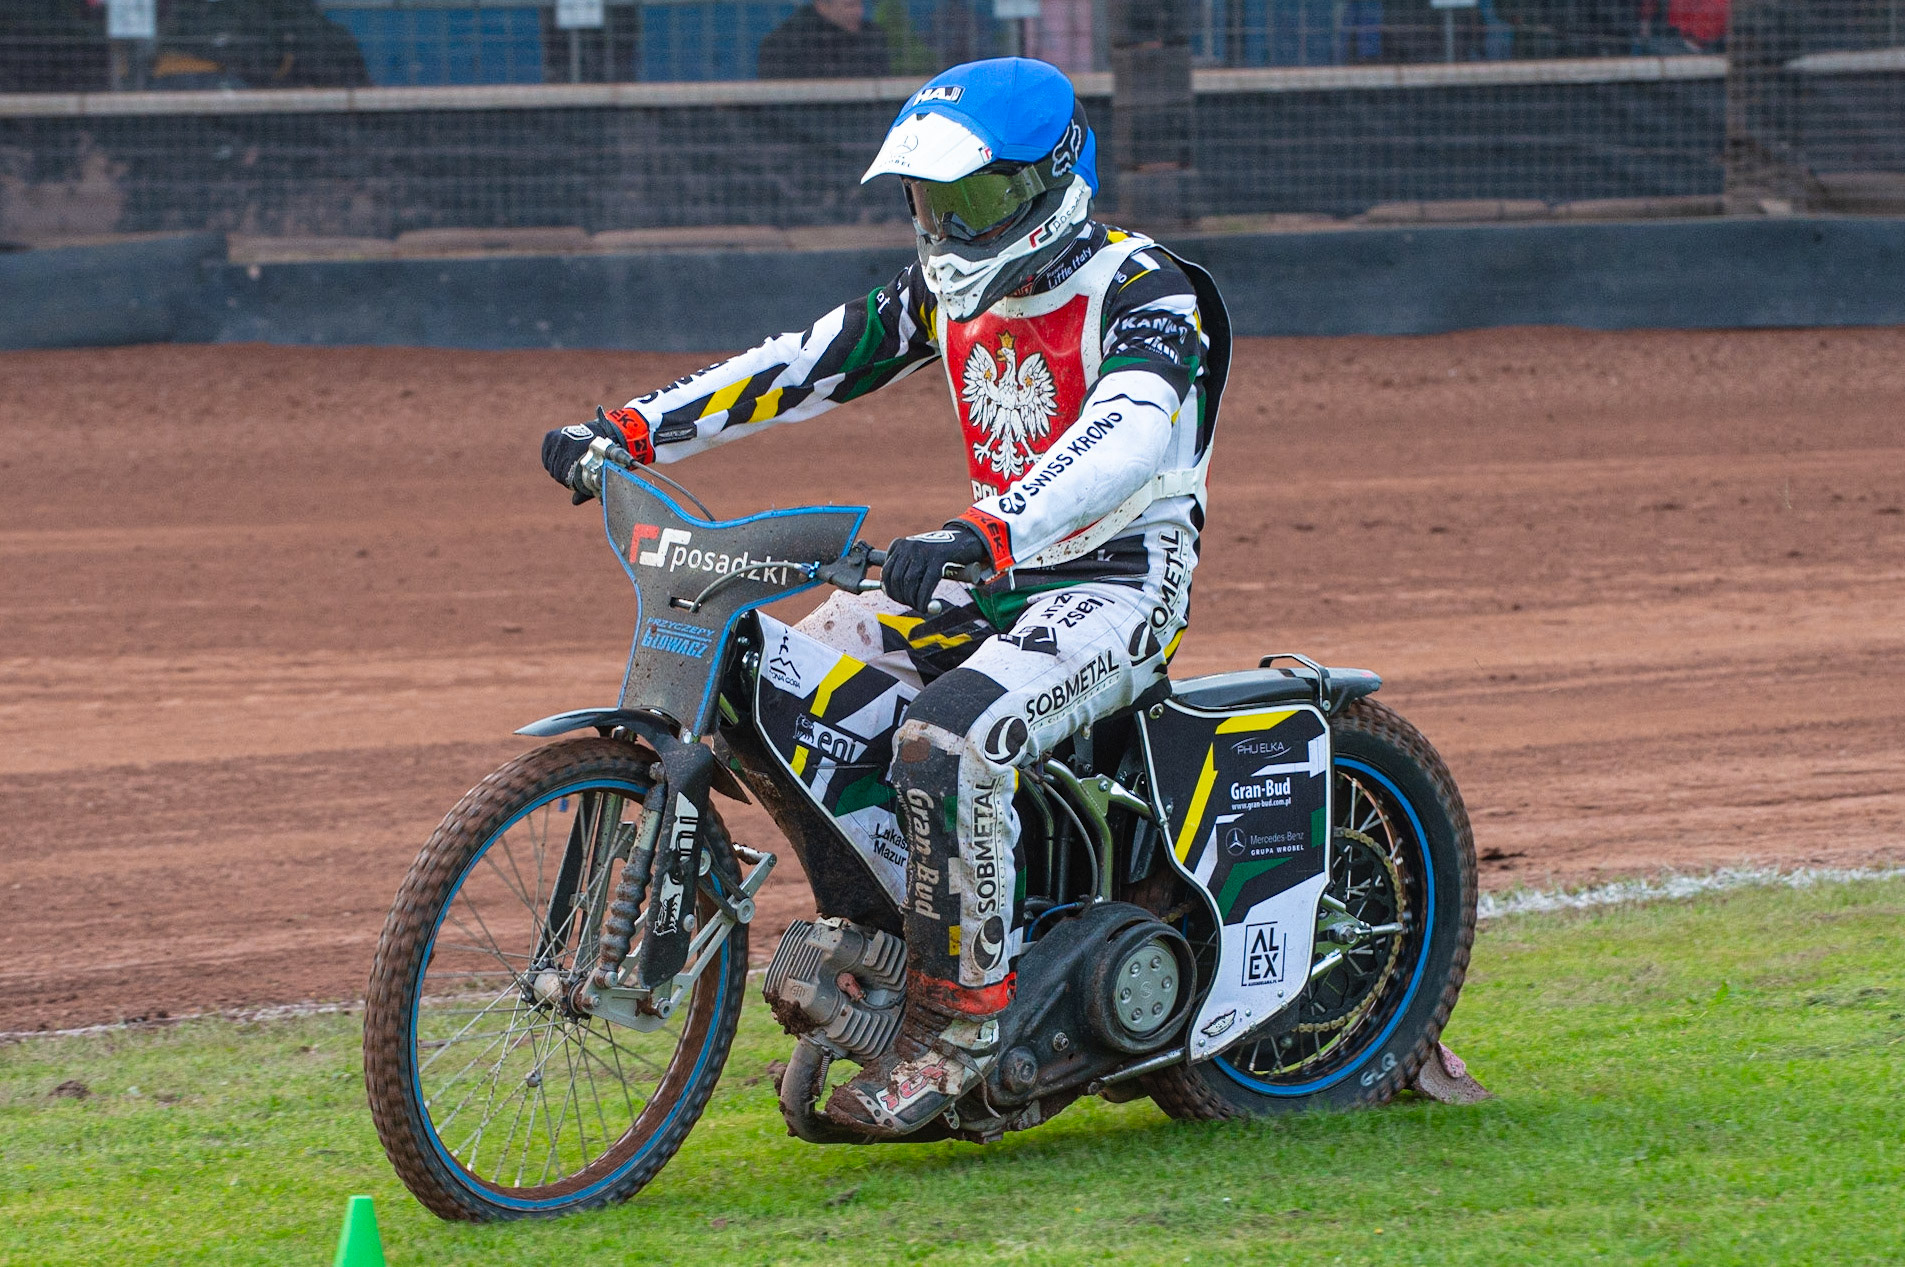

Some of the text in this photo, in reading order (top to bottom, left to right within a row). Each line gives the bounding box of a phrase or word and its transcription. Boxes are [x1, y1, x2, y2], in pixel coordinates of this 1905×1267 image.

[1022, 454, 1074, 497] SWISS
[1026, 650, 1120, 723] SOBMETAL
[817, 731, 857, 763] eni
[1260, 741, 1285, 753] ELKA
[1230, 776, 1291, 801] Gran-Bud
[1231, 797, 1292, 811] www.gran-bud.com.pl
[973, 778, 997, 915] SOBMETAL
[1250, 831, 1304, 845] Mercedes-Benz
[1251, 847, 1274, 856] GRUPA
[873, 839, 907, 867] Mazur
[906, 788, 941, 920] Gran-Bud
